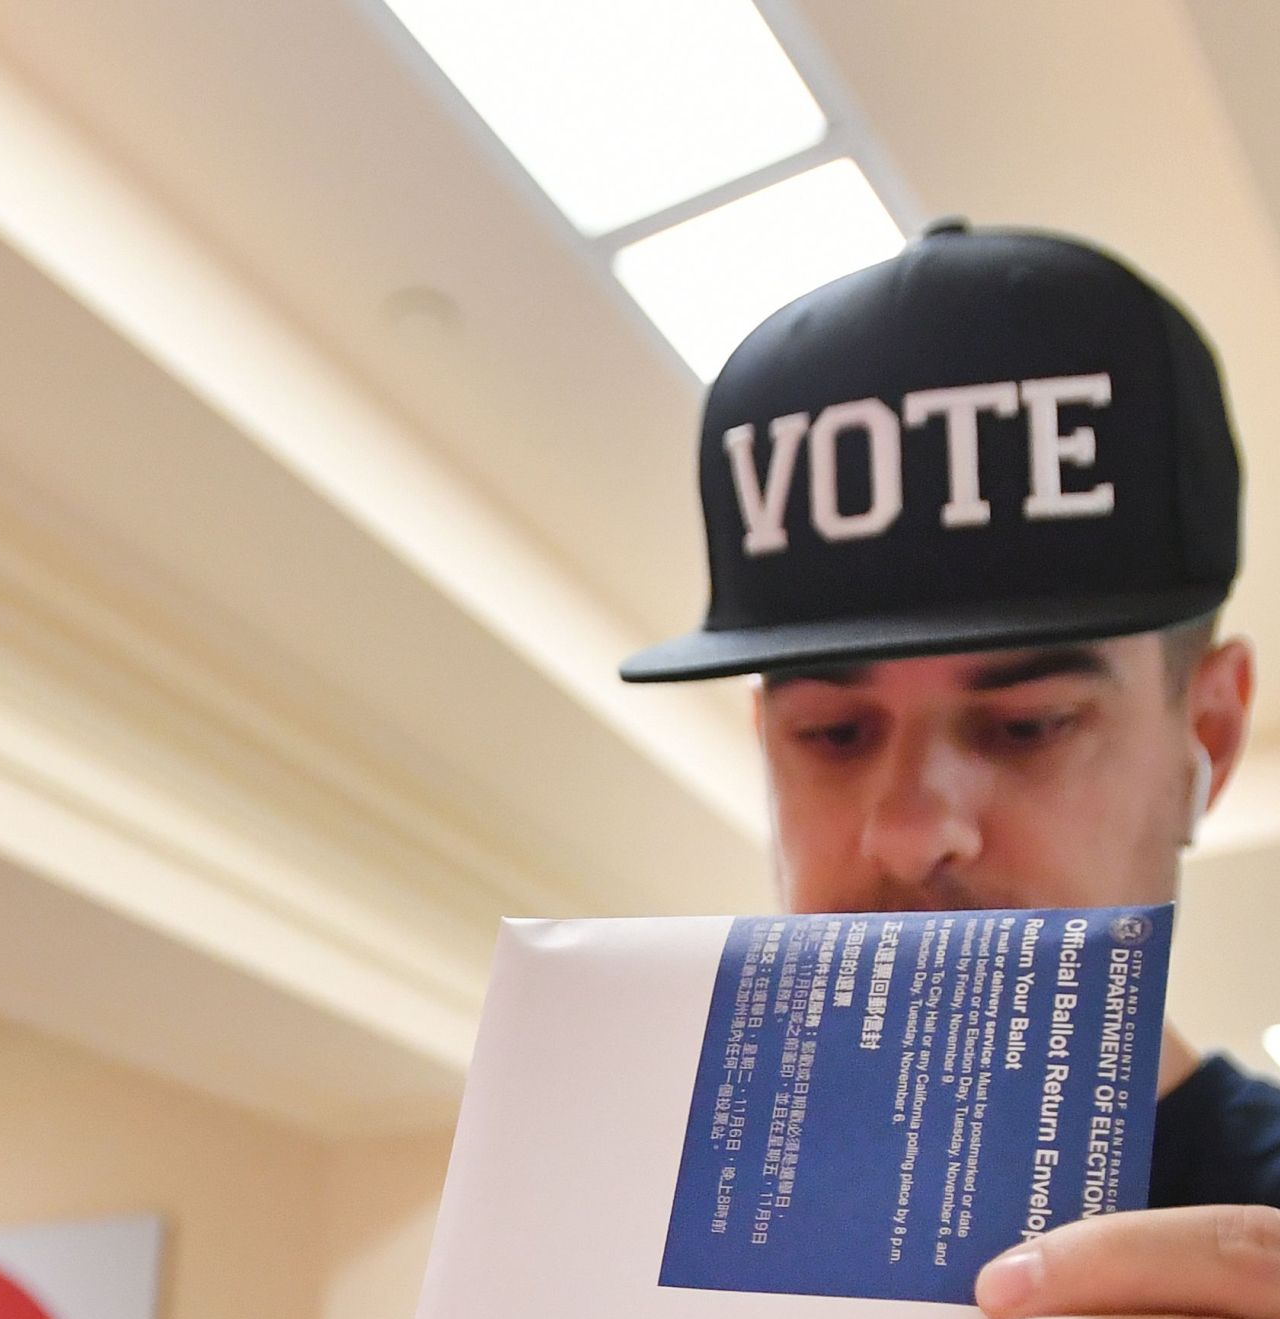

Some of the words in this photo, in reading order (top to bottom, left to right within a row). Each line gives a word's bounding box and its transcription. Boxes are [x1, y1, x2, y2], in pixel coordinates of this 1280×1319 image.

[723, 371, 1115, 558] VOTE
[998, 917, 1015, 928] By
[916, 932, 933, 968] Election
[931, 929, 951, 967] person:
[995, 932, 1011, 952] mail
[1018, 918, 1044, 967] Return
[1055, 918, 1087, 986] Official
[931, 971, 944, 983] To
[955, 958, 971, 971] by
[971, 958, 989, 993] before
[993, 955, 1005, 967] or
[1130, 950, 1142, 979] CITY
[858, 921, 902, 1049] 正式選票回郵信封
[924, 986, 942, 1007] City
[949, 974, 968, 1010] Friday,
[969, 996, 980, 1008] or
[983, 970, 1005, 1017] delivery
[1011, 972, 1035, 1013] Your
[1126, 985, 1139, 1015] AND
[901, 1000, 921, 1047] Tuesday,
[923, 1011, 938, 1032] Hall
[967, 1011, 978, 1024] on
[1047, 993, 1077, 1058] Ballot
[1096, 948, 1129, 1081] DEPARTMENT
[921, 1035, 932, 1046] or
[943, 1013, 962, 1071] November
[960, 1028, 979, 1072] Election
[979, 1020, 998, 1067] service:
[1004, 1017, 1029, 1069] Ballot
[1119, 1022, 1135, 1081] COUNTY
[915, 1050, 930, 1070] any
[893, 1052, 914, 1111] November
[954, 1077, 972, 1101] Day,
[975, 1072, 991, 1100] Must
[1092, 1085, 1115, 1112] OF
[909, 1074, 929, 1128] California
[972, 1104, 987, 1118] be
[1037, 1065, 1068, 1140] Return
[1116, 1090, 1128, 1109] OF
[892, 1114, 904, 1124] 6.
[946, 1106, 968, 1158] Tuesday,
[1112, 1119, 1125, 1145] SAN
[900, 1132, 920, 1170] polling
[960, 1122, 984, 1191] postmarked
[1080, 1116, 1111, 1222] ELECTION
[1105, 1150, 1122, 1212] FRANCIS
[895, 1174, 914, 1205] place
[939, 1161, 960, 1223] November
[961, 1194, 972, 1206] or
[1019, 1149, 1059, 1244] Envelop
[892, 1209, 909, 1222] by
[893, 1226, 906, 1234] 8
[957, 1210, 972, 1237] date
[886, 1238, 903, 1264] p.m.
[933, 1242, 949, 1265] and
